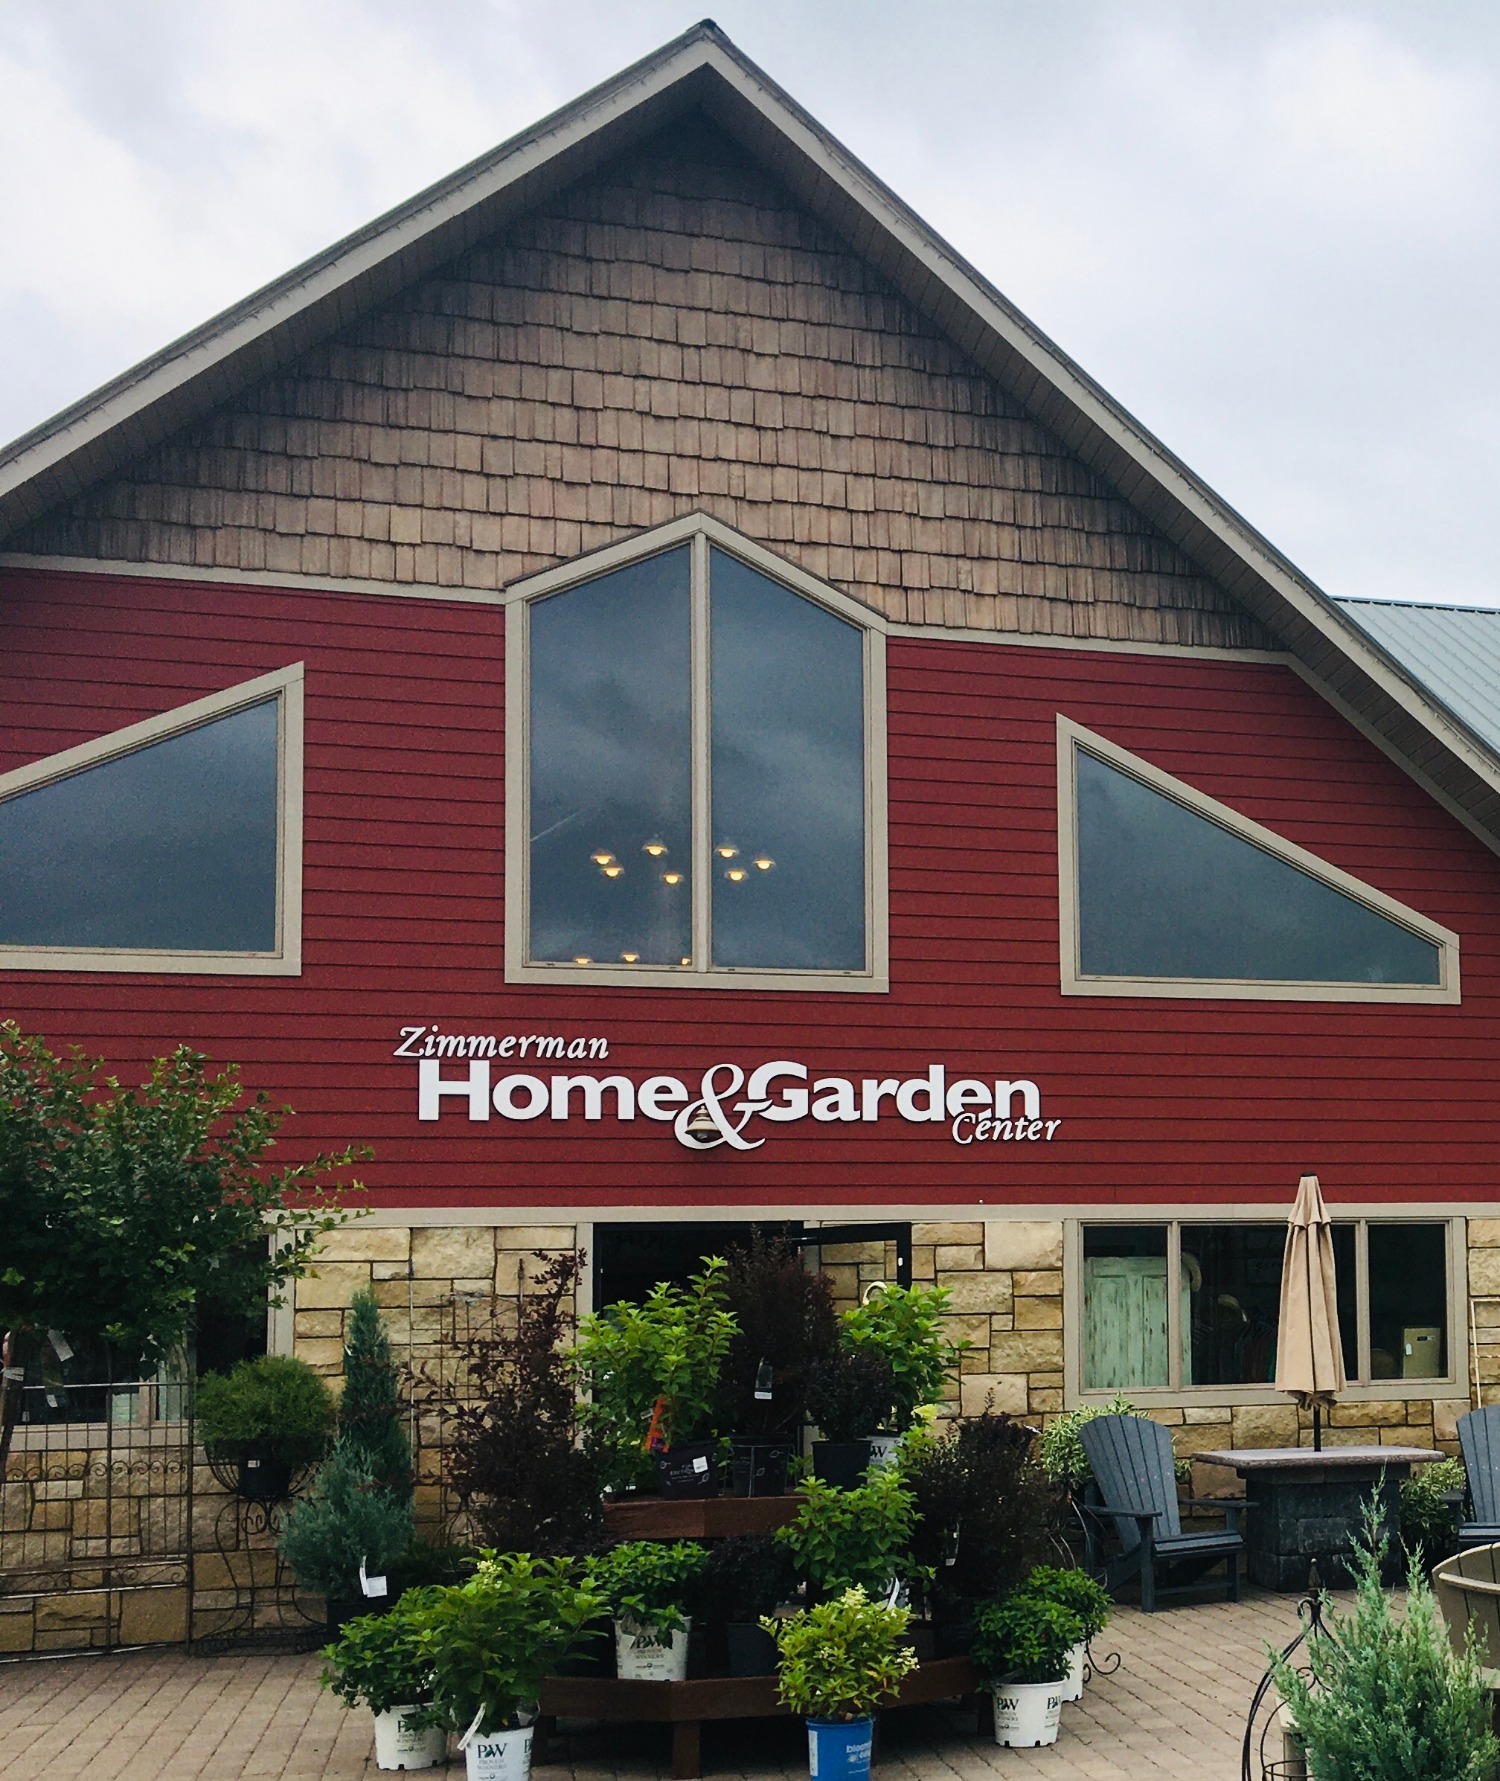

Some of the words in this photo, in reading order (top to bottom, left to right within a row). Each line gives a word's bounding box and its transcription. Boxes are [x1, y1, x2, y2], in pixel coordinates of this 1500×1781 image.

[393, 1025, 609, 1059] Zimmerman
[418, 1058, 689, 1121] Home
[747, 1060, 1040, 1122] Garden
[951, 1112, 1062, 1145] Center
[997, 1698, 1019, 1711] PW
[477, 1743, 507, 1758] PW
